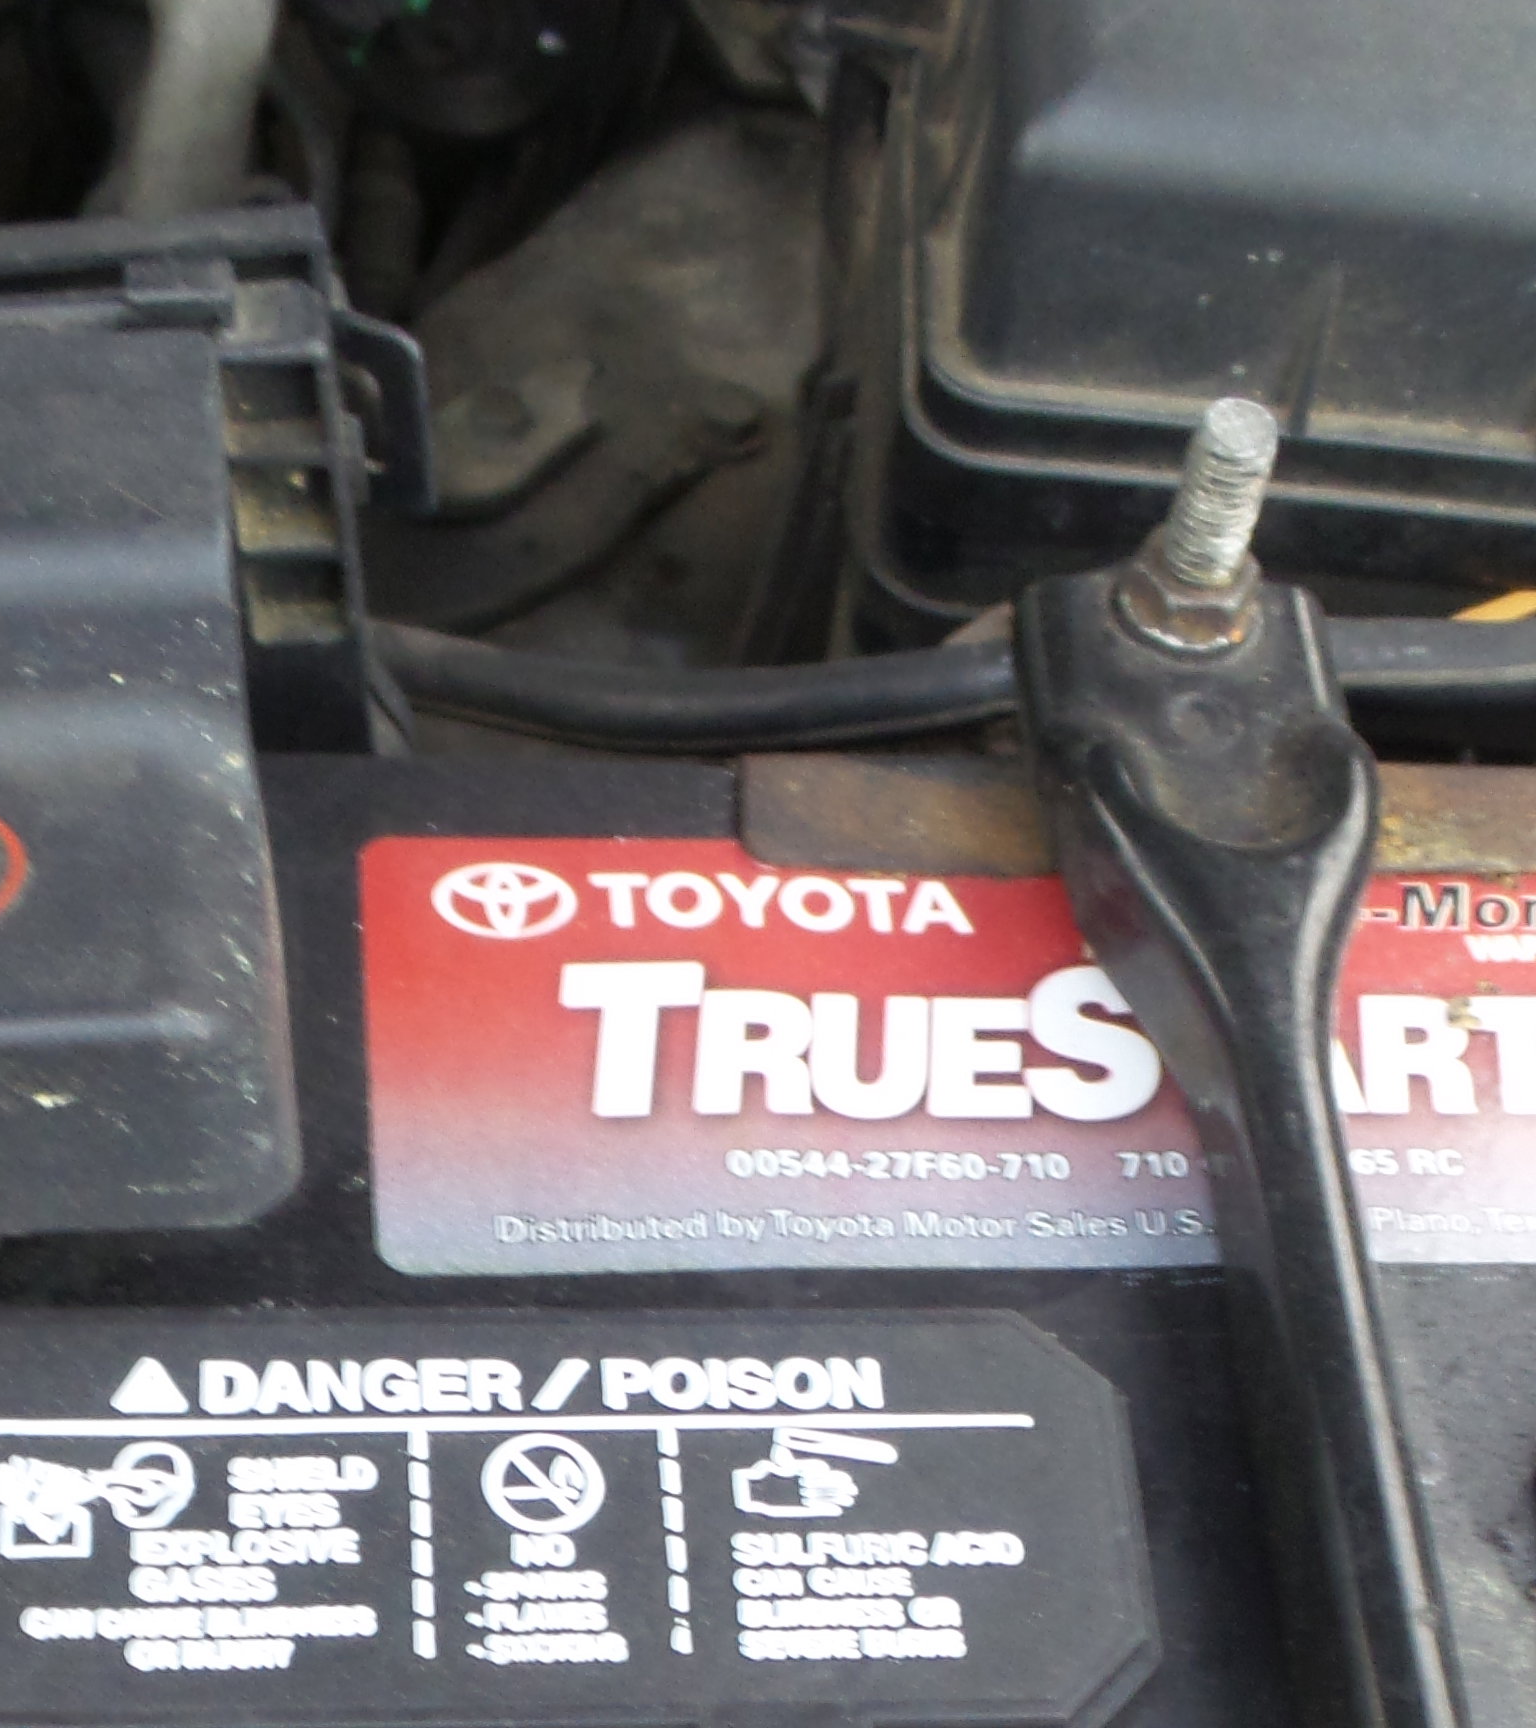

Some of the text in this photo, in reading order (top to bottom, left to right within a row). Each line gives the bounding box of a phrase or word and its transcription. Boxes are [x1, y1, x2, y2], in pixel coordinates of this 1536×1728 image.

[587, 871, 975, 935] TOYOTA
[724, 1149, 1071, 1180] 00544-27F60-710
[1117, 1150, 1190, 1179] 710
[1405, 1148, 1465, 1177] RC
[492, 1209, 708, 1244] Distributed
[715, 1208, 766, 1242] by
[766, 1208, 896, 1243] Toyota
[902, 1209, 1017, 1240] Motor
[1024, 1209, 1128, 1239] Sales
[1366, 1206, 1483, 1236] Plano,
[199, 1356, 524, 1413] DANGER
[600, 1356, 885, 1412] POISON
[226, 1454, 379, 1494] SHIELD
[227, 1493, 343, 1530] EYES
[128, 1527, 362, 1566] EXPLOSIVE
[509, 1532, 577, 1568] NO
[730, 1531, 929, 1567] SULFURIC
[128, 1565, 279, 1603] GASES
